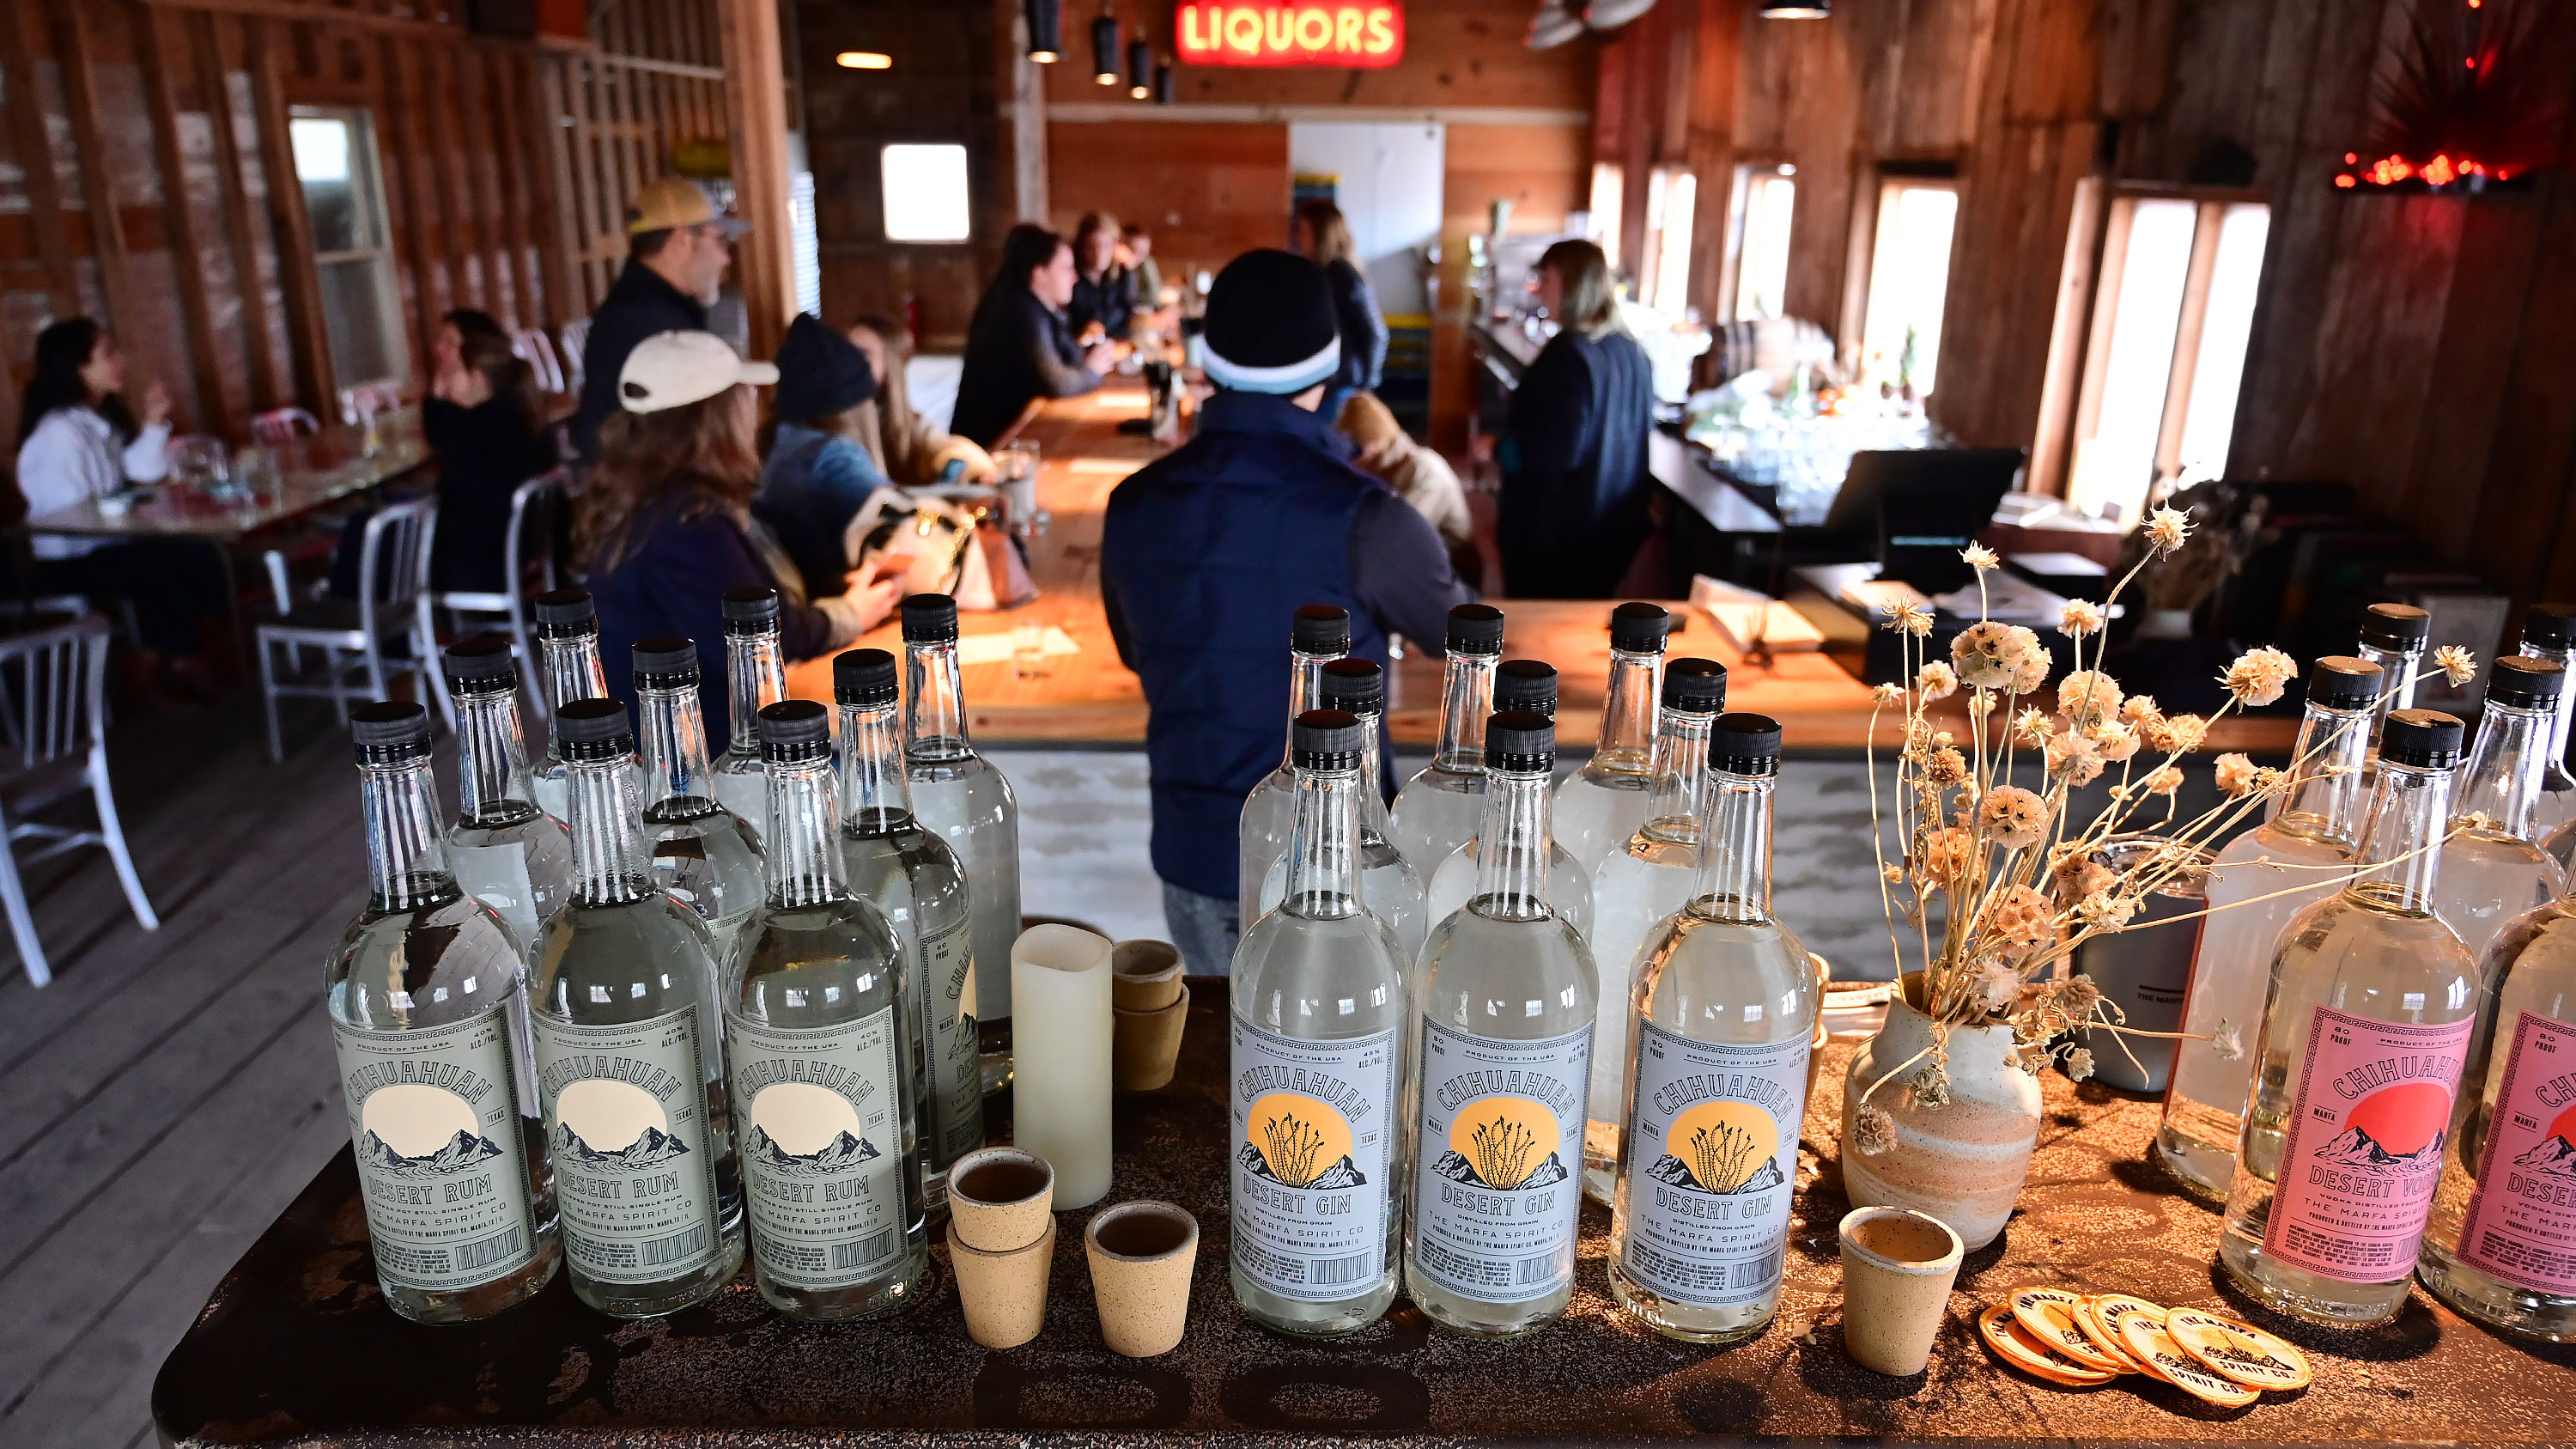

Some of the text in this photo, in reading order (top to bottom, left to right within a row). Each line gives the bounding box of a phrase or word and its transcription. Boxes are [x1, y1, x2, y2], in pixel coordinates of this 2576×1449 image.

[1183, 6, 1394, 55] LIQUORS
[2137, 992, 2154, 1002] THE
[860, 1030, 878, 1039] 40%
[2335, 1026, 2349, 1035] 80
[2540, 1033, 2555, 1042] 80
[1652, 1039, 1663, 1049] 90
[2330, 1034, 2352, 1046] PROOF
[2535, 1041, 2556, 1054] PROOF
[1256, 1044, 1290, 1056] PRODUCT
[1466, 1050, 1504, 1061] PRODUCT
[1686, 1054, 1727, 1065] PRODUCT
[348, 1061, 493, 1105] CHIHUAHUAN
[544, 1056, 682, 1102] CHIHUAHUAN
[738, 1059, 875, 1106] CHIHUAHUAN
[1238, 1065, 1371, 1123] CHIHUAHUAN
[1437, 1070, 1575, 1119] CHIHUAHUAN
[1654, 1075, 1794, 1123] CHIHUAHUAN
[487, 1110, 504, 1123] TEXAS
[676, 1108, 692, 1121] TEXAS
[868, 1112, 884, 1125] TEXAS
[2313, 1108, 2336, 1121] MARFA
[2514, 1115, 2537, 1129] MARFA
[1643, 1122, 1659, 1137] MARFA
[1362, 1134, 1377, 1144] TEXAS
[368, 1173, 492, 1204] DESERT RUM
[560, 1168, 678, 1198] DESERT RUM
[752, 1170, 869, 1202] DESERT RUM
[2308, 1165, 2395, 1198] DESERT
[478, 1196, 496, 1206] RUM
[1243, 1173, 1351, 1215] DESERT GIN
[1442, 1183, 1555, 1216] DESERT GIN
[2320, 1194, 2351, 1204] VODKA
[856, 1198, 872, 1207] RUM
[1656, 1186, 1772, 1220] DESERT GIN
[2305, 1198, 2424, 1220] THE MARFA SPIRIT
[2518, 1202, 2551, 1214] VODKA
[387, 1215, 426, 1226] MARFA
[435, 1211, 482, 1226] SPIRIT
[491, 1202, 506, 1214] CO
[577, 1208, 615, 1221] MARFA
[623, 1208, 668, 1221] SPIRIT
[677, 1200, 691, 1211] CO
[769, 1211, 805, 1224] MARFA
[815, 1212, 859, 1224] SPIRIT
[866, 1204, 881, 1215] CO
[1255, 1206, 1286, 1221] DISTILLED
[2501, 1205, 2530, 1220] THE
[1254, 1215, 1290, 1234] MARFA
[1349, 1226, 1364, 1234] CO
[1429, 1210, 1563, 1239] THE MARFA SPIRIT CO
[1458, 1215, 1493, 1226] DISTILLED
[1673, 1219, 1710, 1229] DISTILLED
[1642, 1214, 1778, 1243] THE MARFA SPIRIT CO
[2020, 1296, 2035, 1310] THE
[2105, 1304, 2137, 1318] MARFA
[1992, 1323, 2008, 1336] THE
[2135, 1321, 2158, 1330] THE
[2180, 1316, 2256, 1339] THE MARFA
[2219, 1360, 2295, 1379] SPIRIT CO.
[2169, 1368, 2245, 1394] SPIRIT CO.
